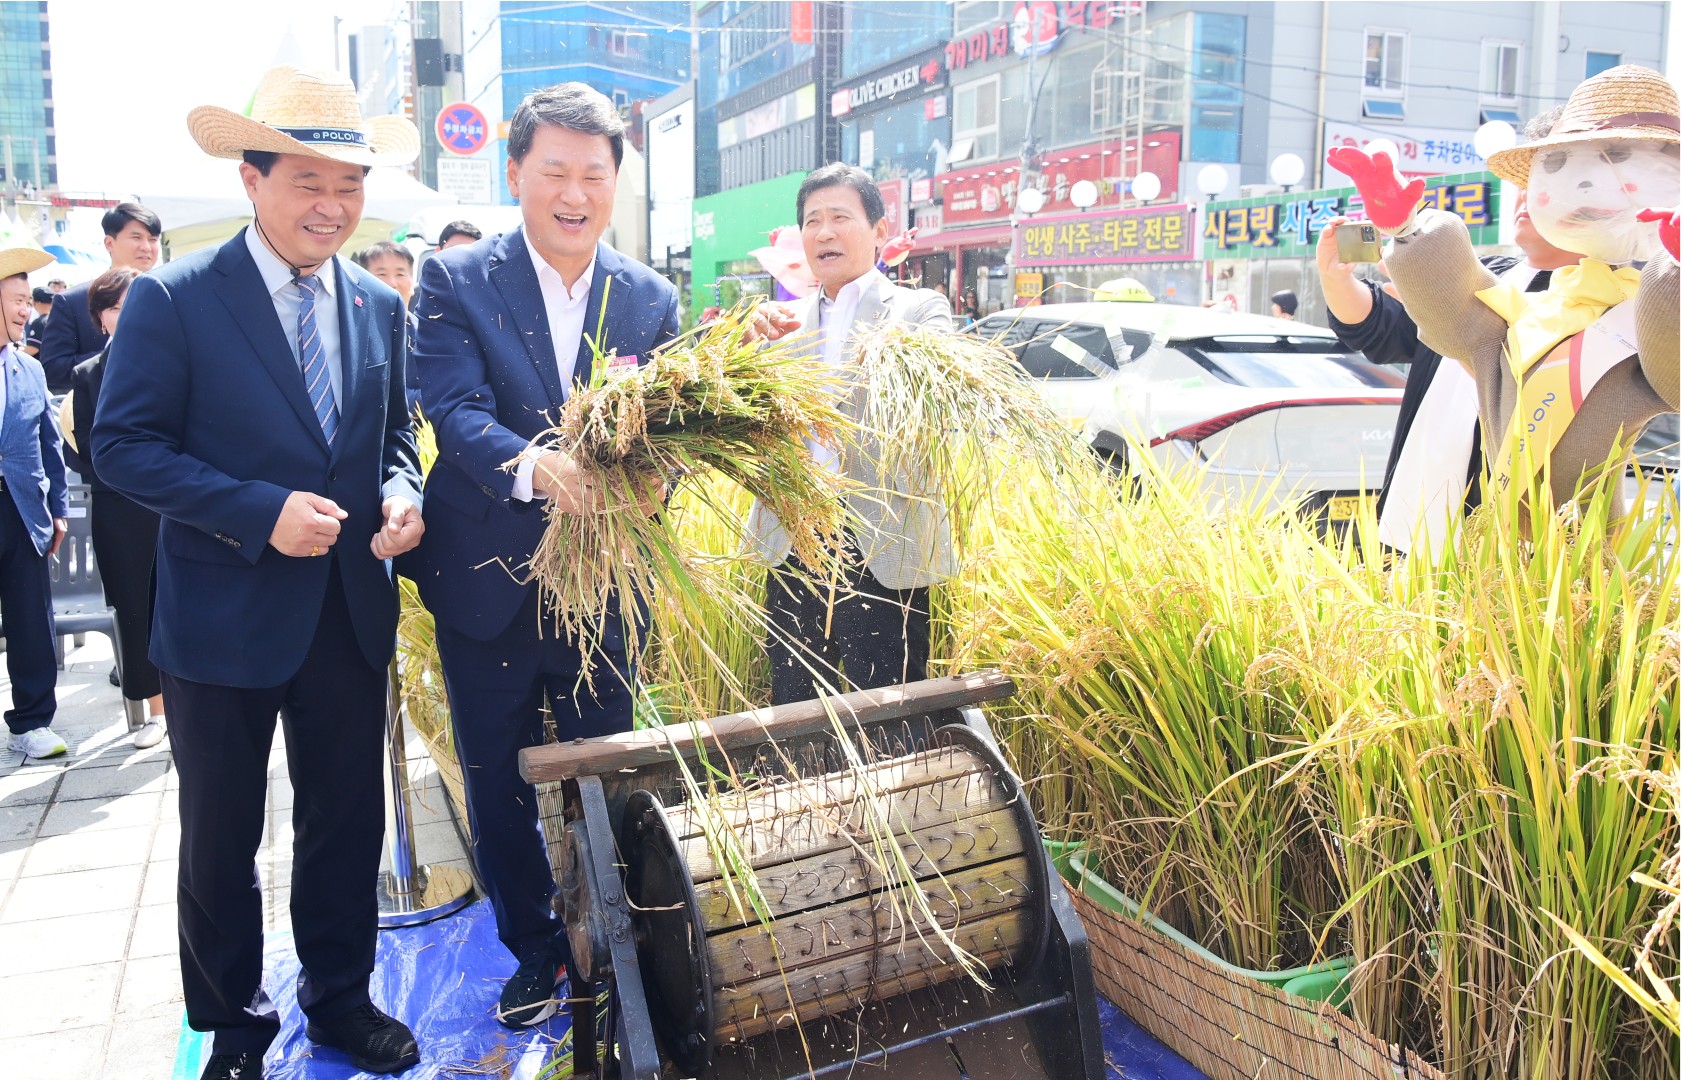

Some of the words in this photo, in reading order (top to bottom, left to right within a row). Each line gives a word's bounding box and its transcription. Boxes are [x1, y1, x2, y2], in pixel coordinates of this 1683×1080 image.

[944, 22, 1008, 70] 개미집
[849, 80, 876, 108] OLIVE
[876, 65, 920, 99] CHICKEN
[1025, 226, 1055, 256] 인생
[1143, 215, 1183, 250] 전문
[1204, 204, 1277, 249] 시크릿
